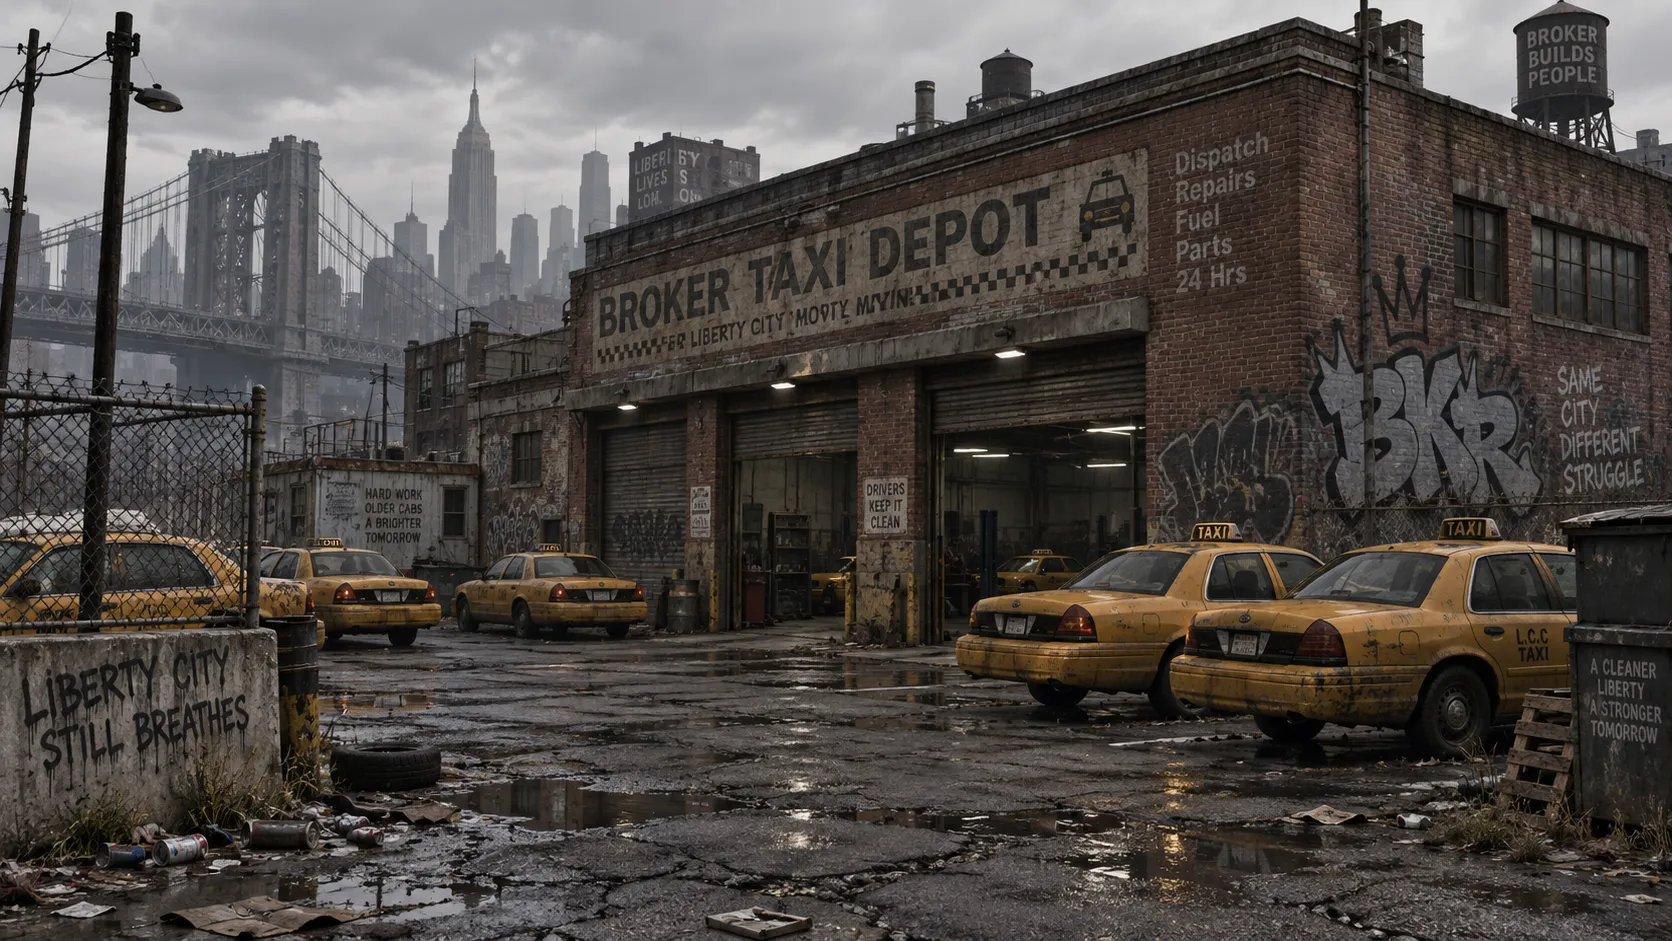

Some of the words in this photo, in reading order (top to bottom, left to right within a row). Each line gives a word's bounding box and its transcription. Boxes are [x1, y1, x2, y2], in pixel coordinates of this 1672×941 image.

[1527, 24, 1597, 49] BROKER
[1528, 45, 1595, 68] BUILDS
[1528, 65, 1597, 89] PEOPLE
[1175, 131, 1269, 175] Dispatch
[637, 169, 668, 192] LIVES
[1175, 168, 1256, 204] Repairs
[1175, 203, 1220, 234] Fuel
[1176, 234, 1233, 264] Parts
[599, 268, 730, 338] BROKER
[748, 237, 847, 304] TAXI
[869, 187, 1050, 280] DEPOT
[1176, 267, 1202, 293] 24
[1210, 262, 1247, 288] Hrs
[691, 320, 746, 348] LIBERTY
[751, 312, 784, 336] CITY
[1557, 364, 1604, 396] SAME
[1561, 397, 1600, 428] CITY
[1560, 425, 1641, 461] DIFFERENT
[1563, 458, 1645, 494] STRUGGLE
[365, 487, 391, 500] HARD
[395, 488, 423, 501] WORK
[866, 482, 905, 496] DRIVERS
[364, 502, 395, 514] OLDER
[398, 503, 423, 515] CABS
[869, 499, 891, 513] KEEP
[893, 499, 903, 512] IT
[364, 517, 372, 530] A
[375, 517, 422, 529] BRIGHTER
[870, 515, 900, 529] CLEAN
[1198, 525, 1228, 540] TAXI
[1446, 520, 1483, 537] TAXI
[364, 531, 422, 544] TOMORROW
[1518, 646, 1549, 662] TAXI
[1590, 658, 1599, 675] A
[1602, 658, 1657, 679] CLEANER
[21, 655, 158, 730] LIBERTY
[173, 645, 230, 690] CITY
[1597, 678, 1645, 700] LIBERTY
[1589, 699, 1598, 716] A
[1600, 701, 1662, 724] STRONGER
[40, 718, 125, 773] STILL
[132, 694, 250, 754] BREATHES
[1590, 720, 1658, 744] TOMORROW
